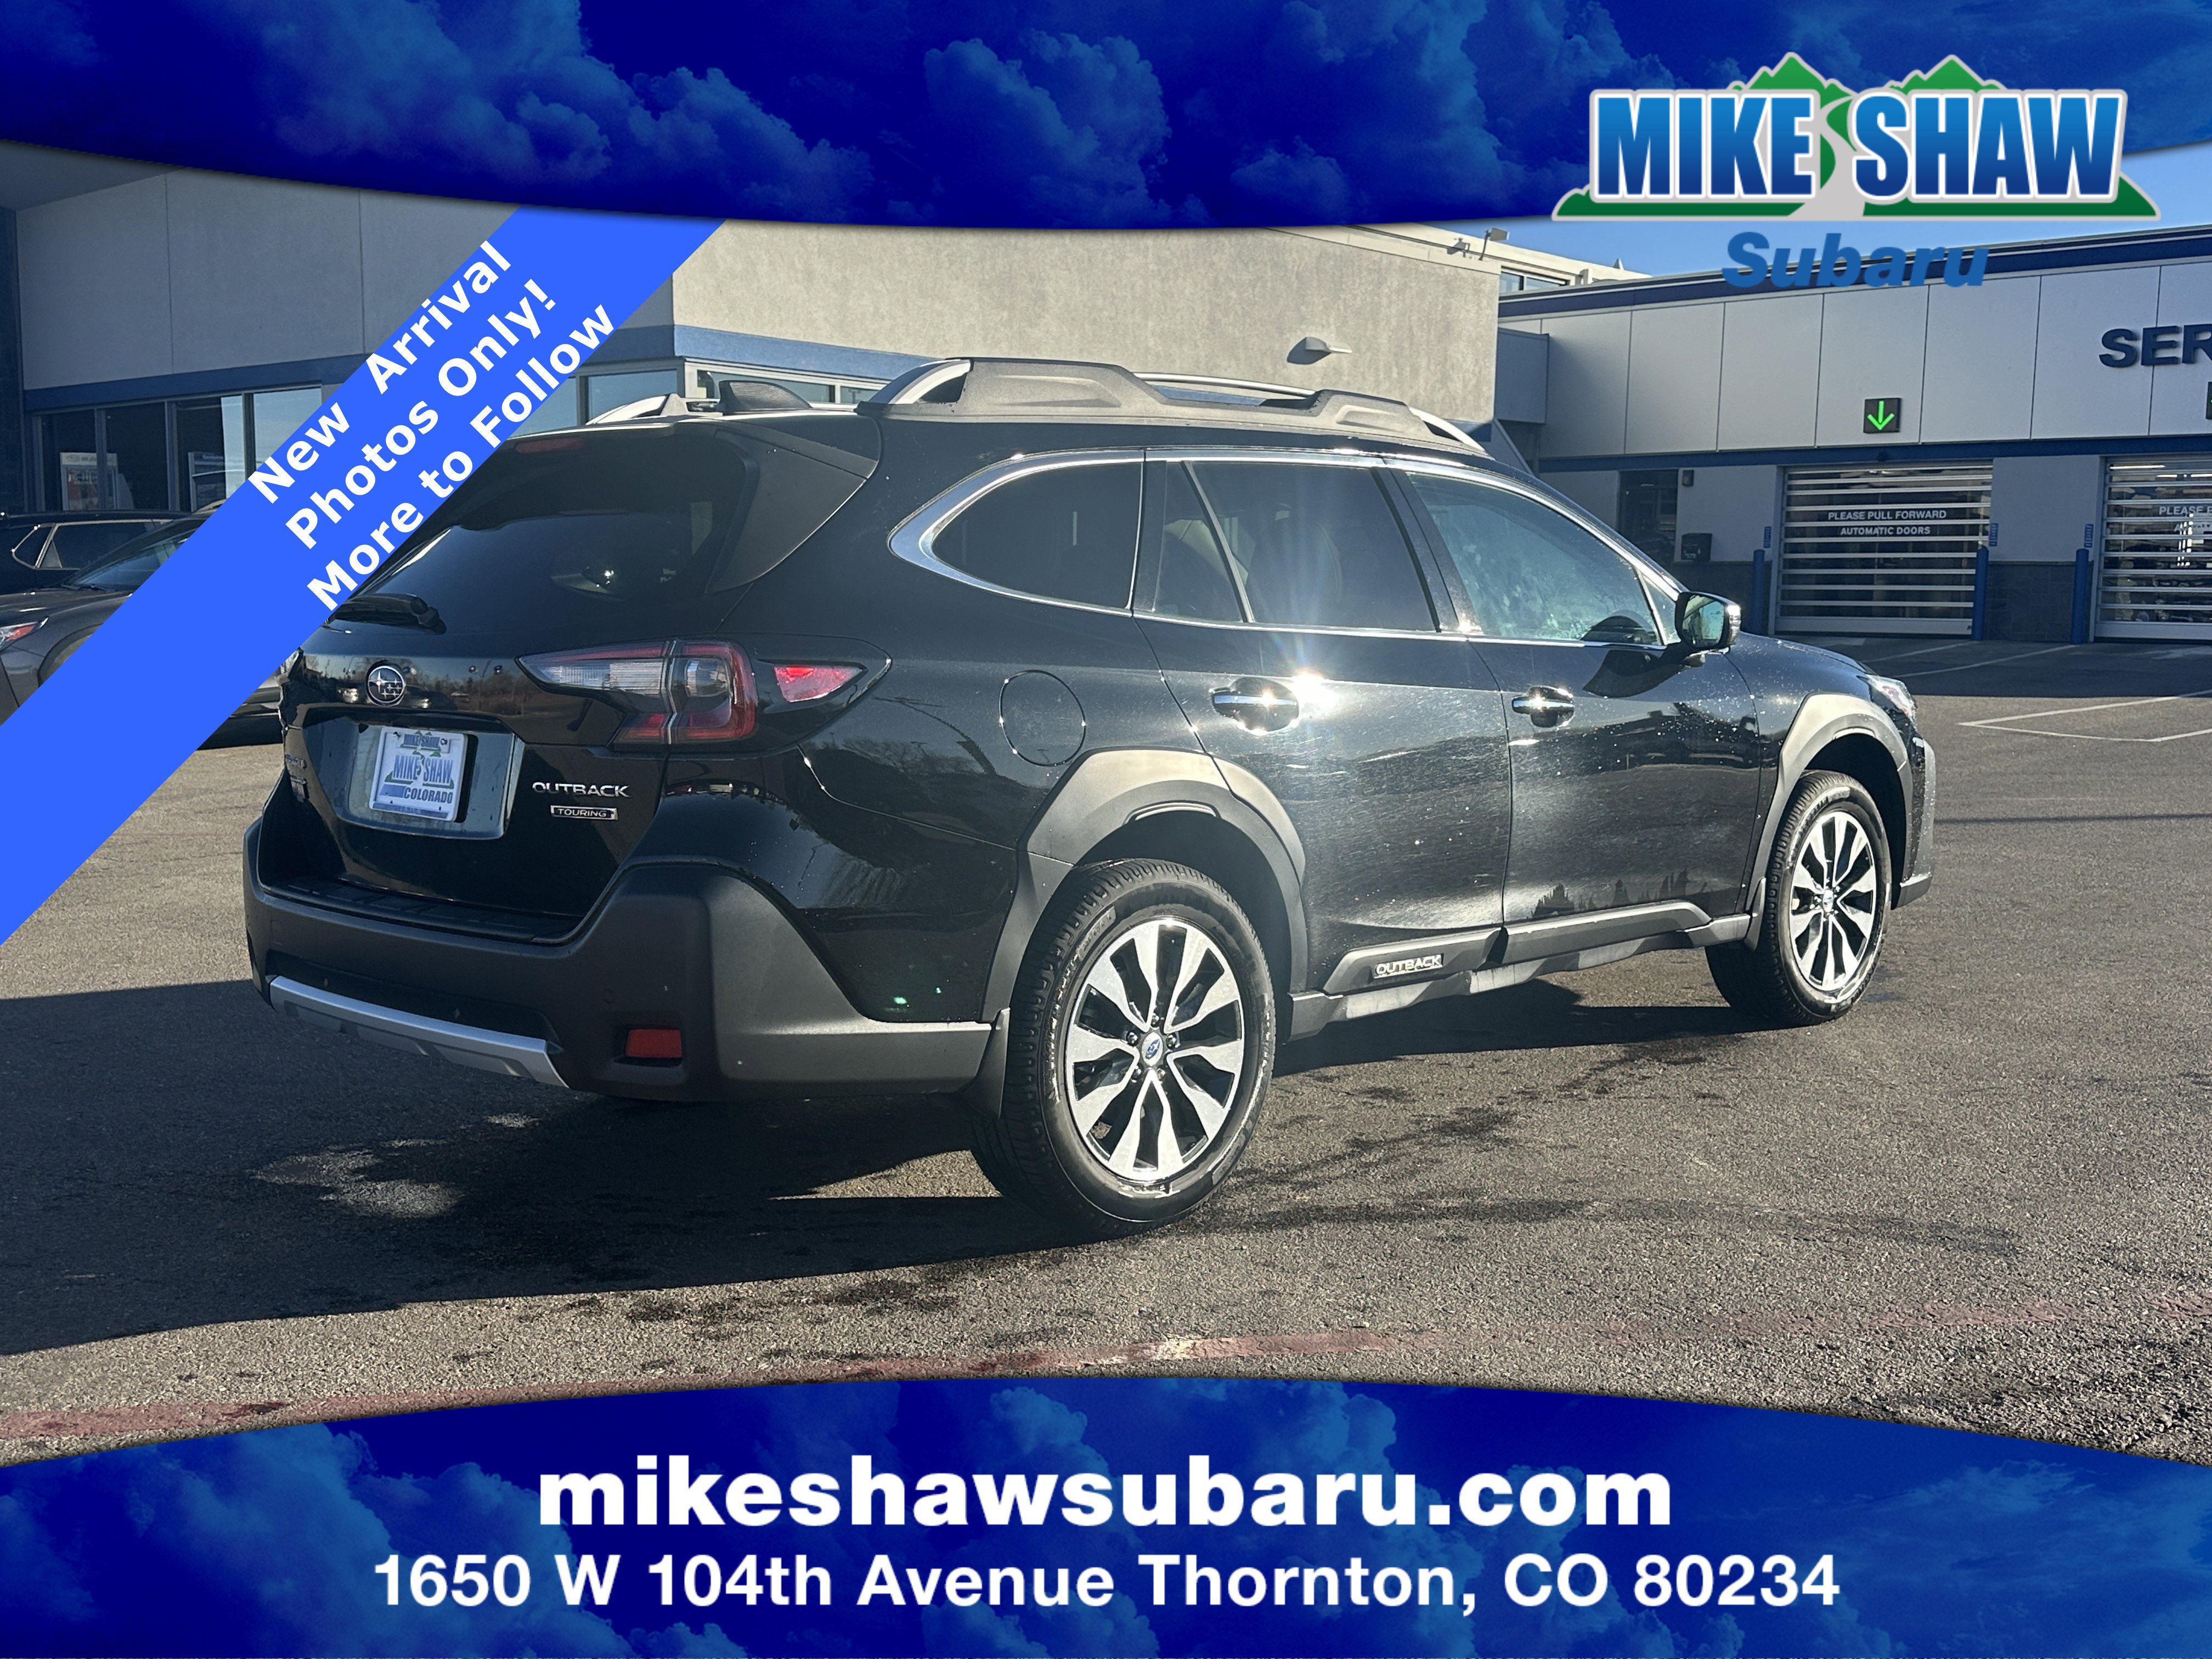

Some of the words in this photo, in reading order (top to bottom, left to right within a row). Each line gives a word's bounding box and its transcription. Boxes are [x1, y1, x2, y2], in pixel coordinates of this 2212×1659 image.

[1827, 511, 1865, 521] PLEASE
[1867, 510, 1893, 520] PULL
[1895, 510, 1946, 520] FORWARD
[2159, 506, 2204, 515] PLEASE
[1839, 527, 1894, 535] AUTOMATIC
[1896, 526, 1931, 535] DOORS
[392, 754, 421, 780] MIKE
[424, 757, 454, 784] SHAW
[403, 787, 454, 804] COLORADO
[532, 781, 631, 798] OUTBACK
[557, 808, 608, 817] TOURING
[1375, 953, 1443, 975] OUTBACK
